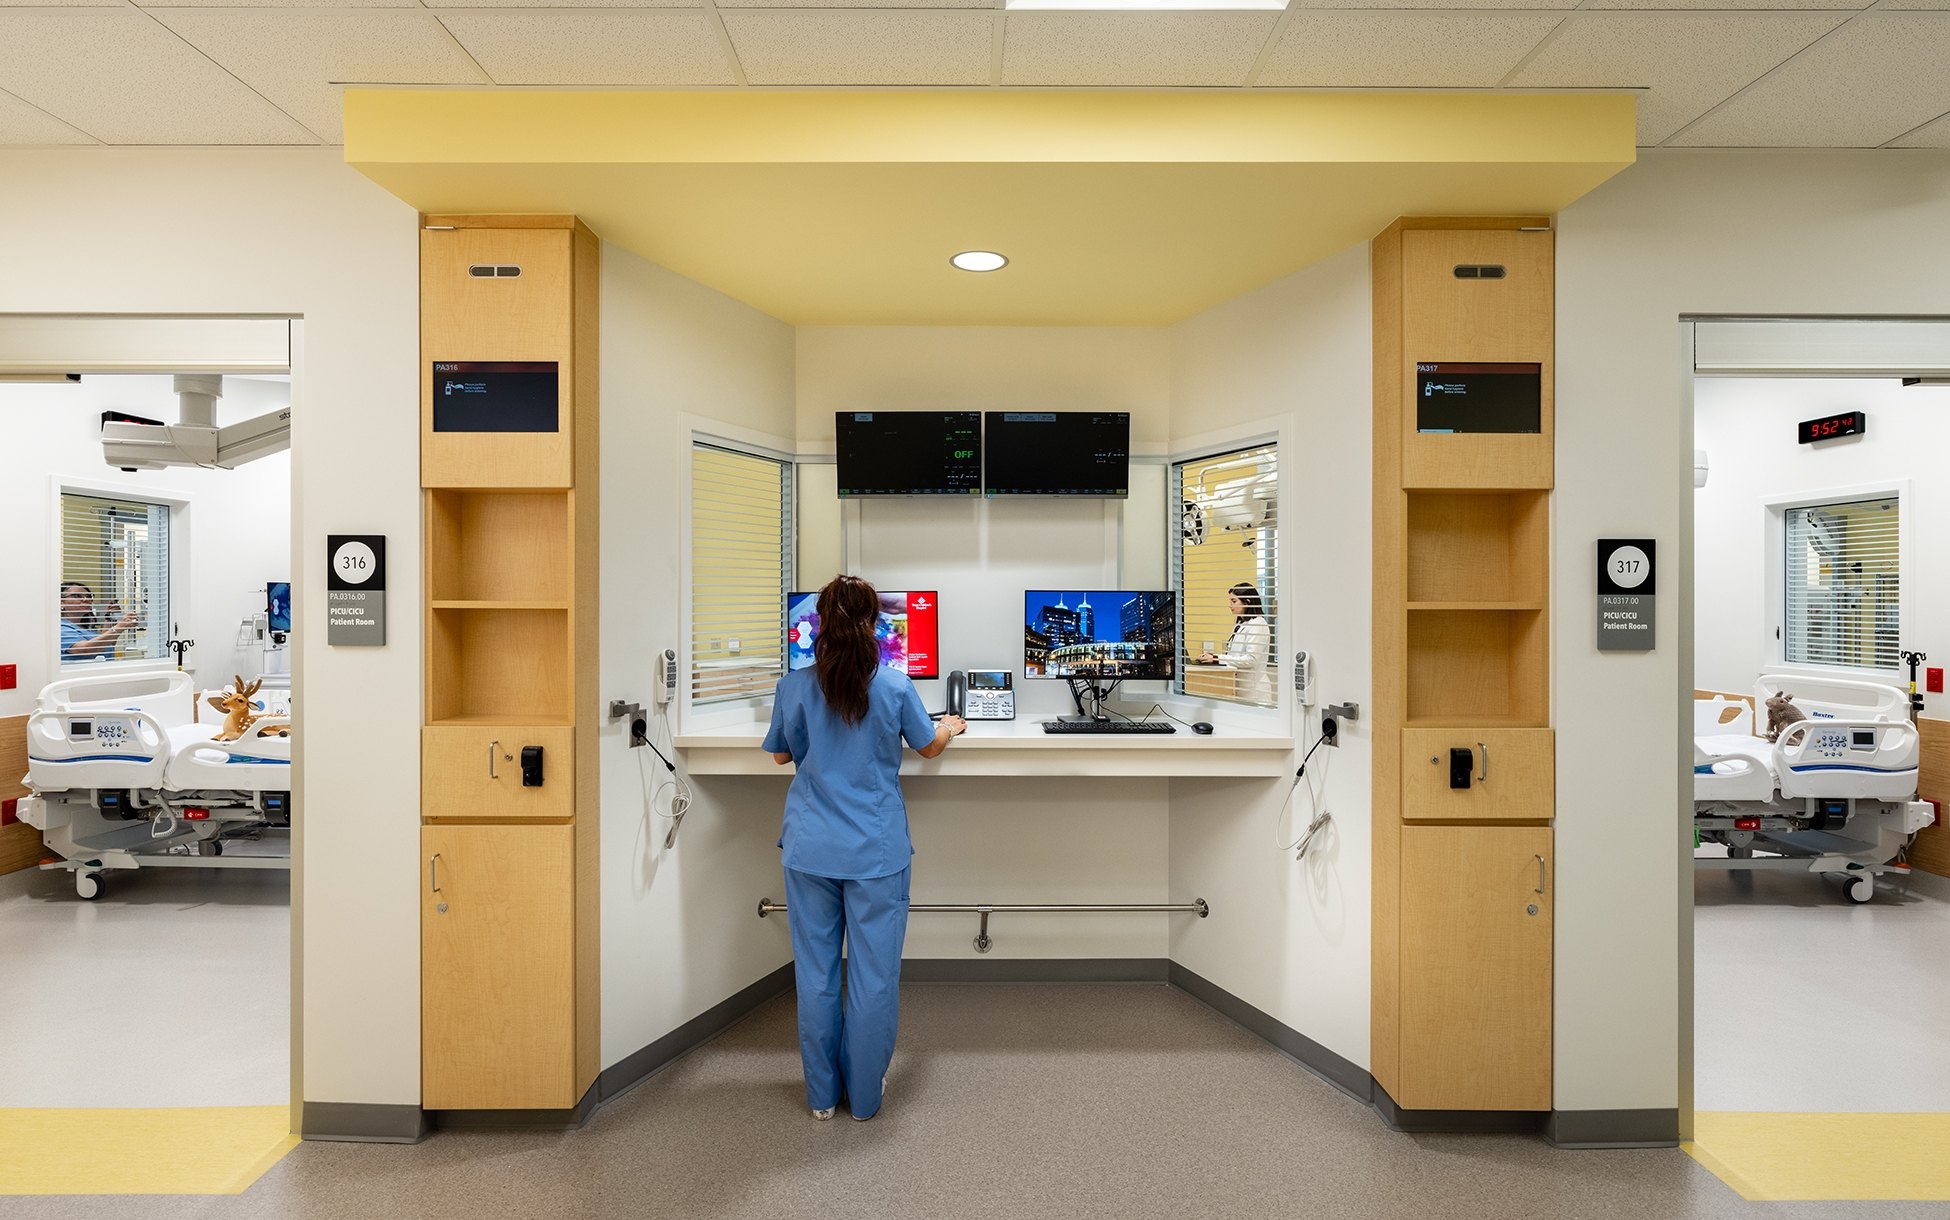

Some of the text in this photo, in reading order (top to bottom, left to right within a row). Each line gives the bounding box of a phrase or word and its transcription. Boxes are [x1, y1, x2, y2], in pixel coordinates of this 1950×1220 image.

[1811, 419, 1839, 437] 9:52
[954, 450, 974, 459] OFF
[343, 556, 367, 569] 316
[1617, 560, 1640, 574] 317
[330, 593, 366, 601] PA.0316.00
[1603, 597, 1639, 605] PA.0317.00
[330, 607, 364, 615] PICU/CICU
[1603, 611, 1638, 620] PICU/CICU
[330, 618, 375, 626] Patient Room
[1603, 622, 1648, 630] Patient Room
[1812, 711, 1835, 719] Baxter
